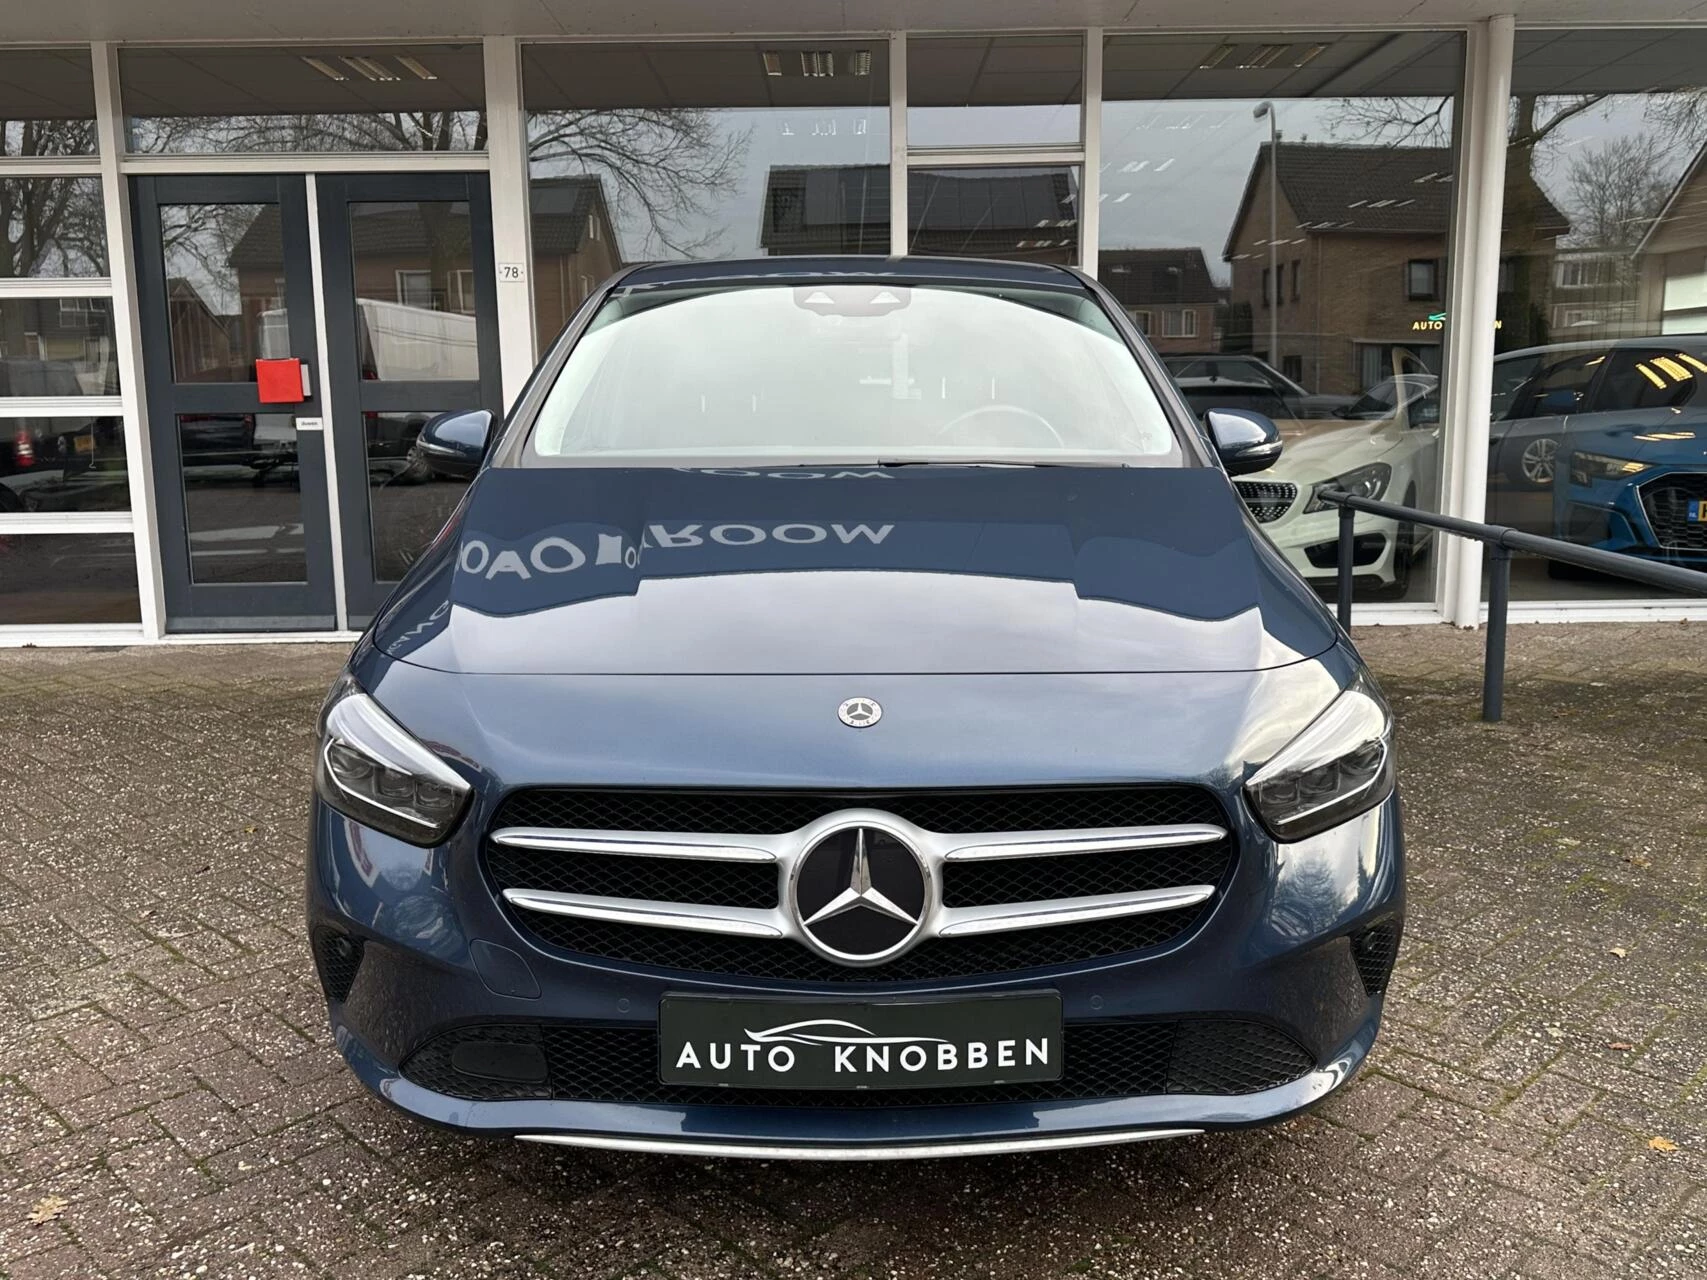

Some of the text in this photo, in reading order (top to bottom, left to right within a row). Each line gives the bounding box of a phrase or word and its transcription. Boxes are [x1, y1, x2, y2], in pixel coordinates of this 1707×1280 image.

[504, 266, 519, 279] 78
[1412, 321, 1443, 330] AUTO
[676, 1037, 1049, 1073] AUTO KNOBBEN
